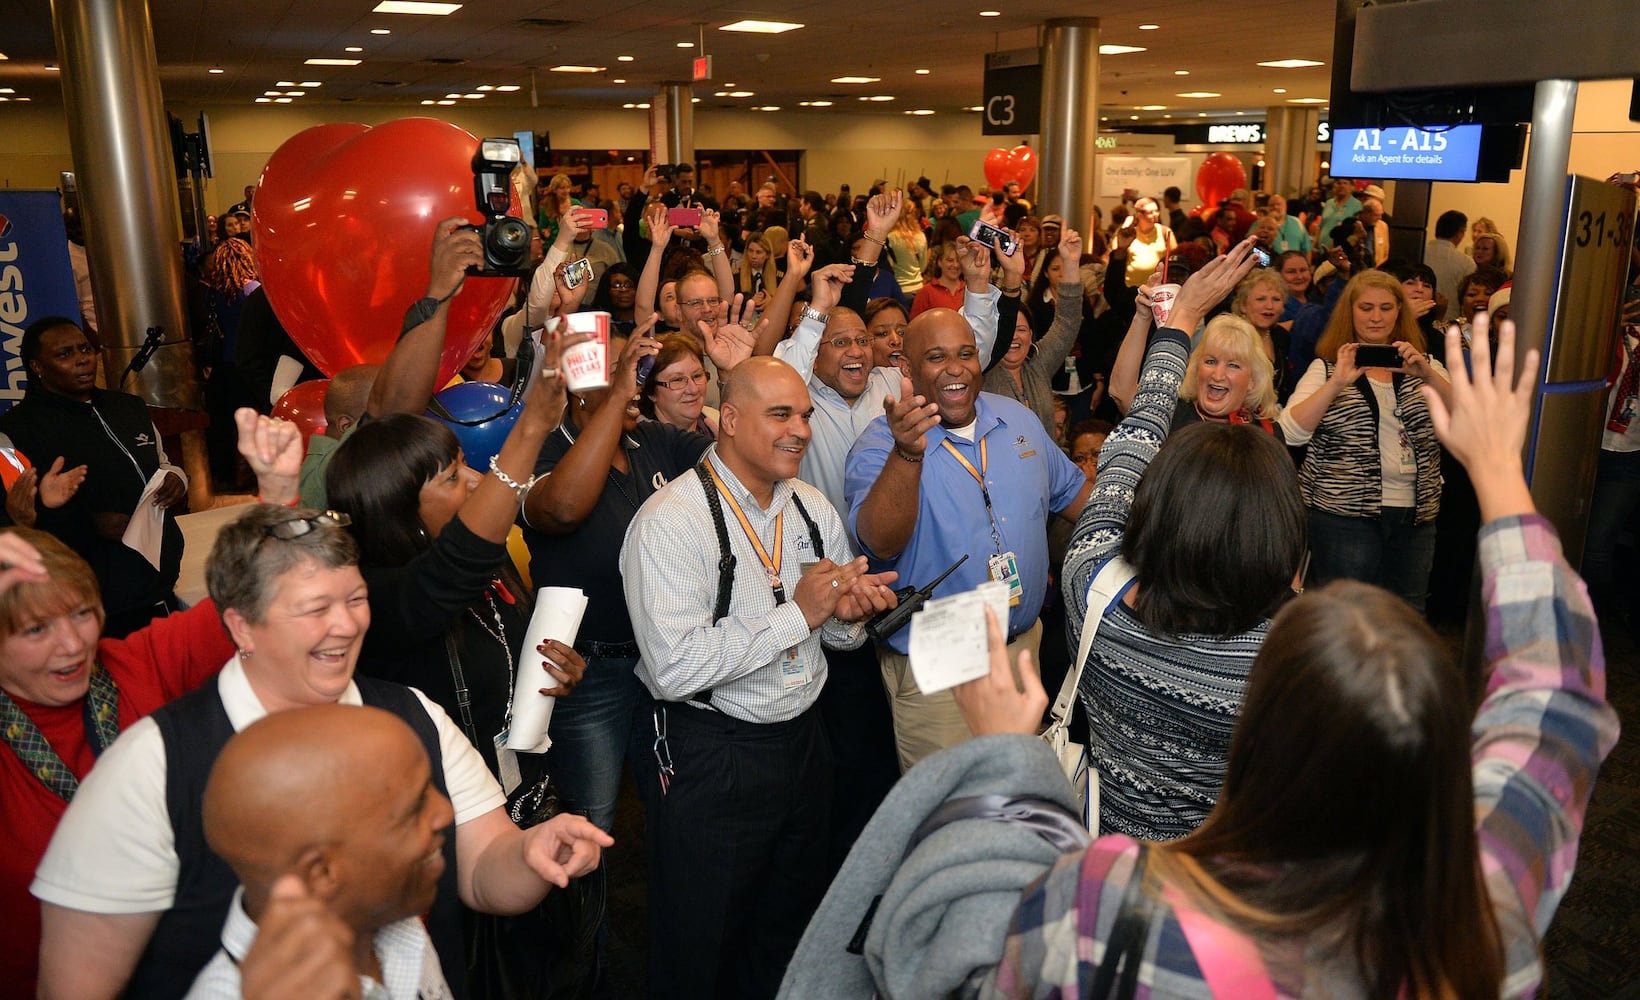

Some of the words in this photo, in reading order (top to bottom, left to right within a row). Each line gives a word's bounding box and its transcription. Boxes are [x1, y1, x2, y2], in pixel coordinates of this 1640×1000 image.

[987, 95, 1015, 125] C3
[1208, 125, 1261, 143] BREWS
[1352, 129, 1382, 151] A1
[1400, 128, 1449, 151] A15
[1352, 153, 1366, 163] Ask
[1367, 154, 1377, 163] an
[1377, 154, 1401, 166] Agent
[1402, 153, 1414, 164] for
[1415, 153, 1443, 165] details
[1106, 167, 1119, 176] One
[1145, 167, 1159, 177] One
[0, 242, 28, 404] hwest
[566, 349, 600, 368] PHILLY
[571, 361, 602, 379] STEAKS
